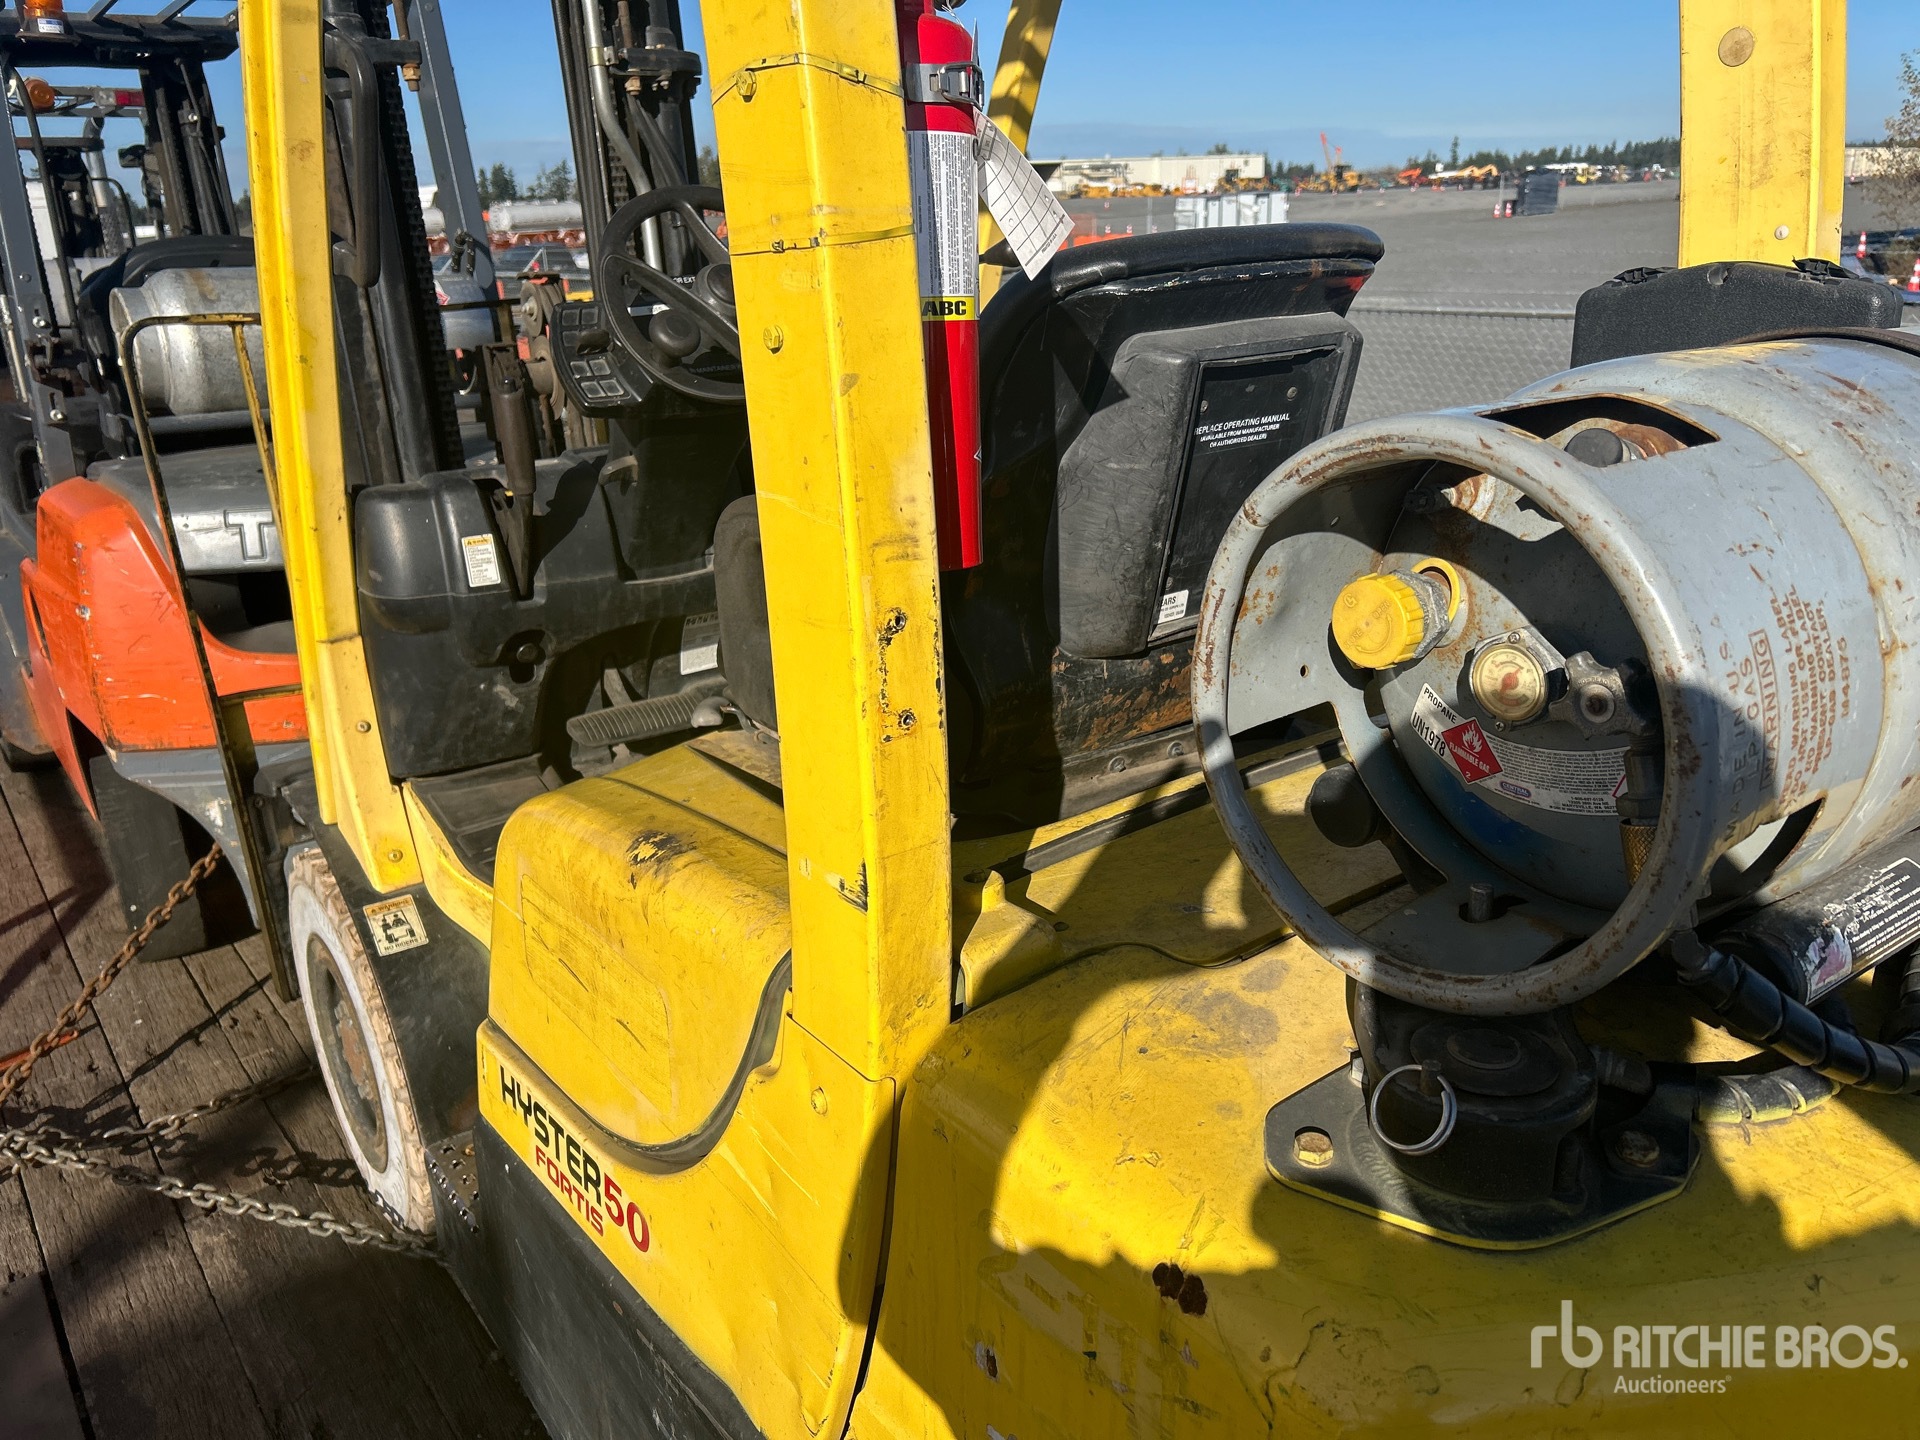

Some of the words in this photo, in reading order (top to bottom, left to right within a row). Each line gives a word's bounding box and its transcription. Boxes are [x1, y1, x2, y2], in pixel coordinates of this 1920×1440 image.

[922, 300, 967, 317] ABC
[1223, 417, 1260, 430] OPERATING
[1260, 413, 1290, 424] MANUAL
[1227, 429, 1241, 437] FROM
[1241, 423, 1280, 435] MANUFACTURER
[1216, 436, 1247, 447] AUTHORIZED
[1162, 596, 1177, 606] ARS
[1343, 593, 1357, 608] G
[1371, 600, 1390, 620] OPEN
[1782, 594, 1799, 637] FILL
[1789, 584, 1811, 644] LABEL
[1795, 644, 1806, 670] OR
[1803, 601, 1826, 682] CONTACT
[1423, 688, 1457, 724] PROPANE
[1755, 639, 1777, 783] WARNING
[1788, 662, 1800, 750] WARNING
[1801, 681, 1809, 718] USE
[1807, 654, 1818, 741] WARNING
[1412, 712, 1446, 757] UN1978
[1733, 707, 1746, 737] IN
[1740, 656, 1760, 777] LP-GAS
[1812, 690, 1828, 774] PRESENT
[1823, 690, 1836, 759] LP-GAS
[1449, 742, 1479, 767] FLAMMABLE
[1478, 759, 1490, 773] GAS
[1798, 728, 1808, 762] NOT
[1804, 747, 1815, 772] NO
[1465, 771, 1471, 779] 2
[500, 1065, 602, 1207] HYSTER
[604, 1172, 650, 1253] 50
[536, 1145, 604, 1237] FORTIS
